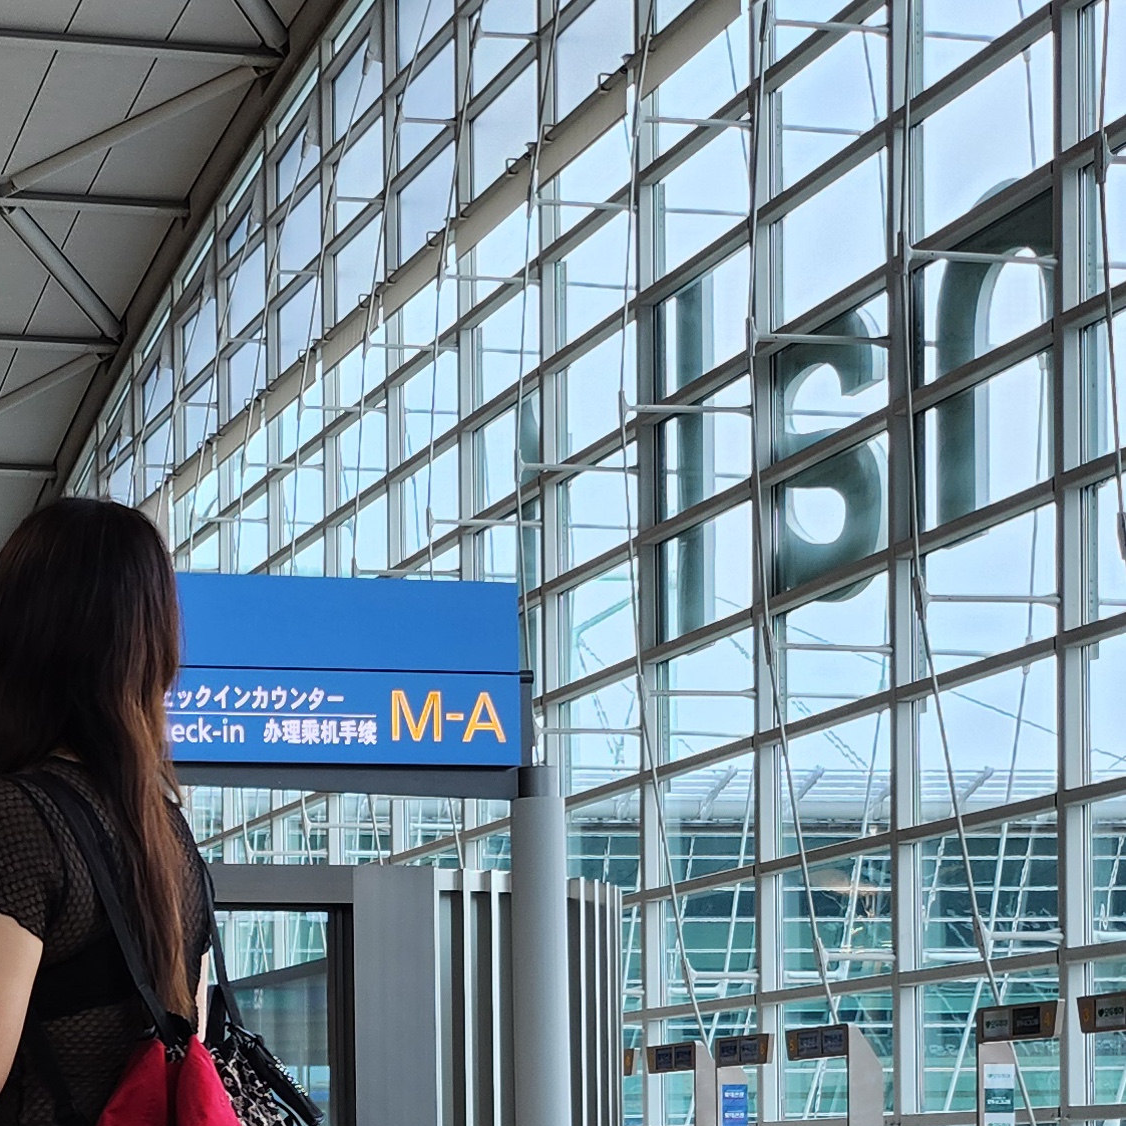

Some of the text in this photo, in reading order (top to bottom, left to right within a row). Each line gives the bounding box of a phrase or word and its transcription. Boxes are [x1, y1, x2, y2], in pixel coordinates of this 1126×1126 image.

[263, 718, 377, 745] 办理乘机手续
[391, 689, 507, 744] M-A
